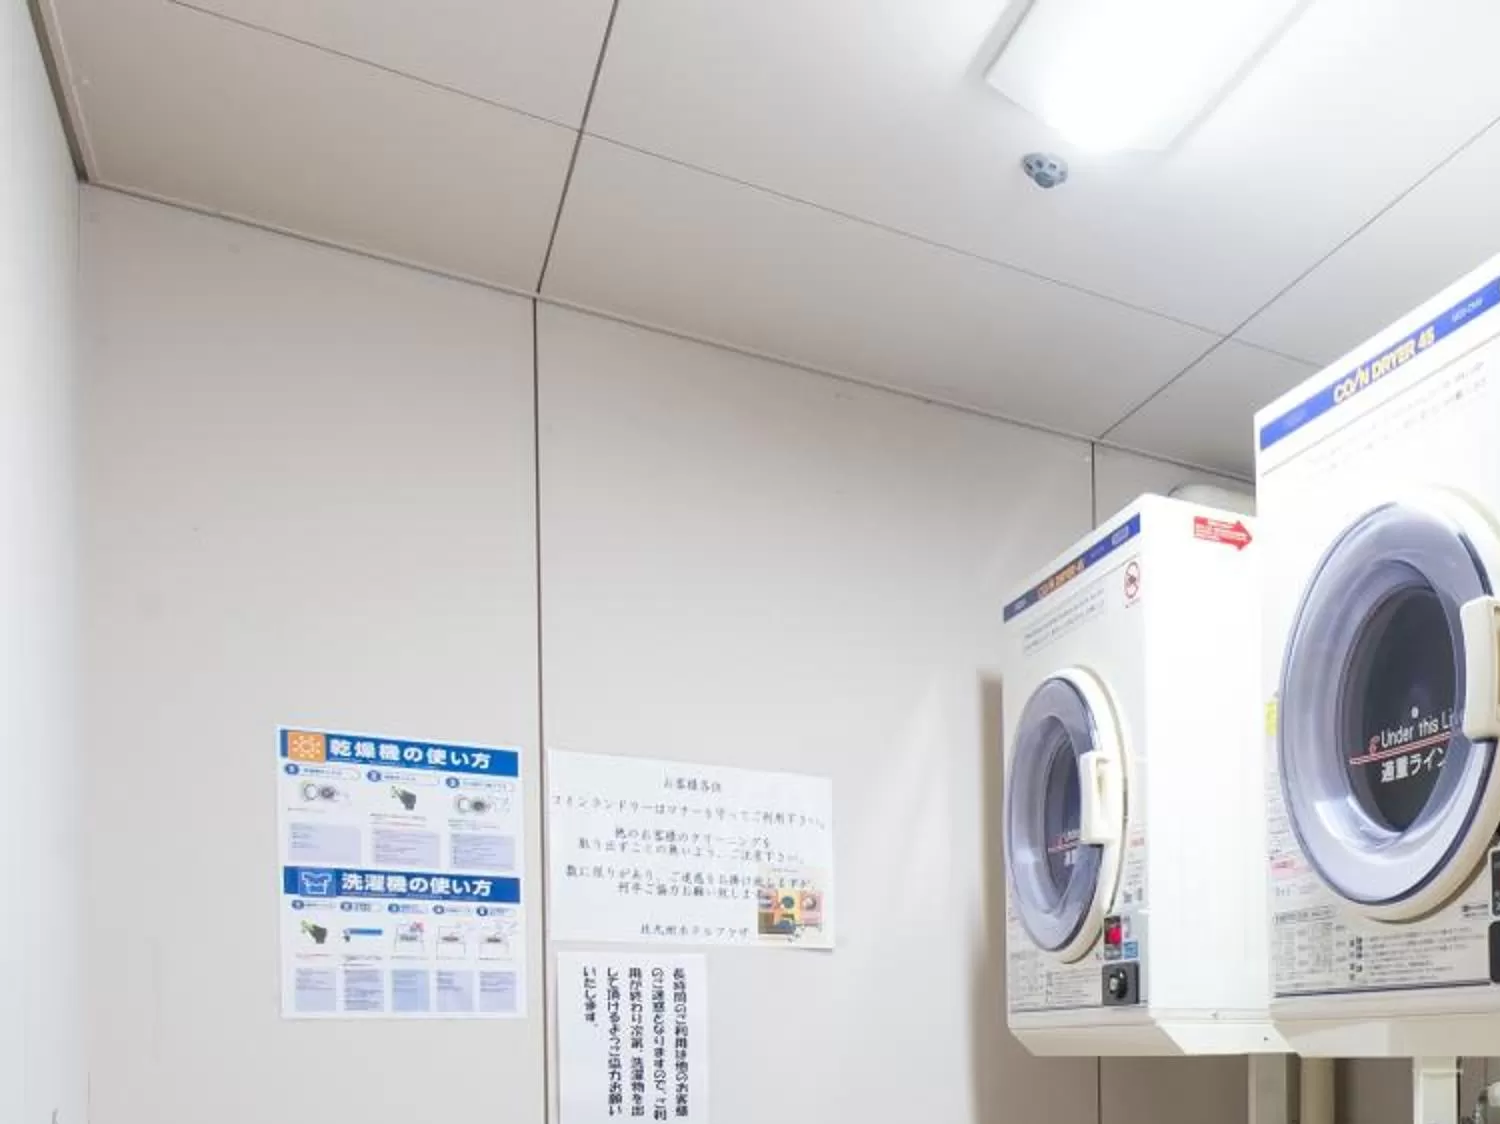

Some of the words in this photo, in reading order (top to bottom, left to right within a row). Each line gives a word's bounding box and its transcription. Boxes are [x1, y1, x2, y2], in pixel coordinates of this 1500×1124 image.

[1381, 726, 1413, 749] Under
[1419, 715, 1439, 738] this
[329, 737, 492, 770] 乾燥機の使い方
[1380, 747, 1446, 784] 適量ライン
[341, 872, 493, 897] 洗濯機の使い方
[583, 965, 600, 1029] いたします。
[673, 967, 689, 1117] 長時間のご利用は他のお客様
